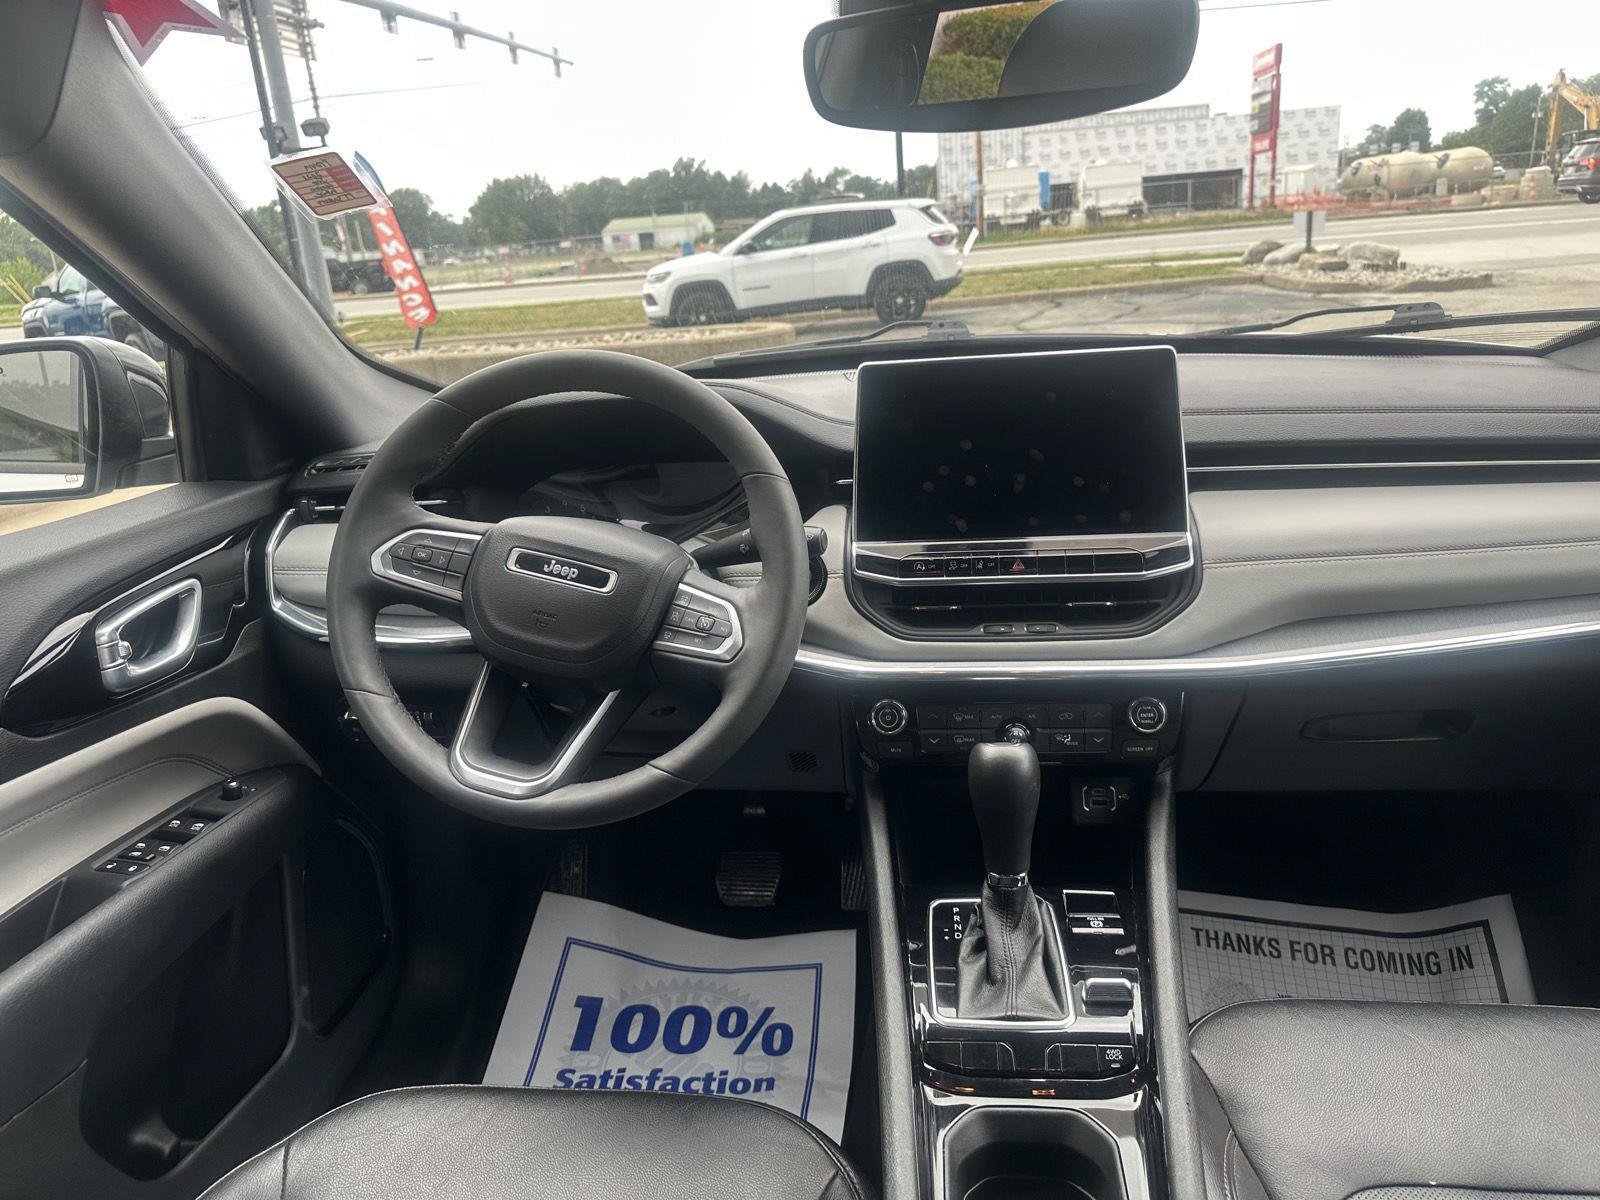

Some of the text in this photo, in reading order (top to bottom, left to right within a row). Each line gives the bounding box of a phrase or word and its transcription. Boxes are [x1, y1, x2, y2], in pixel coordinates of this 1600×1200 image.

[543, 559, 579, 579] Jeep
[1190, 927, 1474, 977] THANKS FOR COMING IN
[569, 995, 794, 1057] 100%
[1105, 1048, 1122, 1056] 4WD
[553, 1066, 776, 1096] Satisfaction
